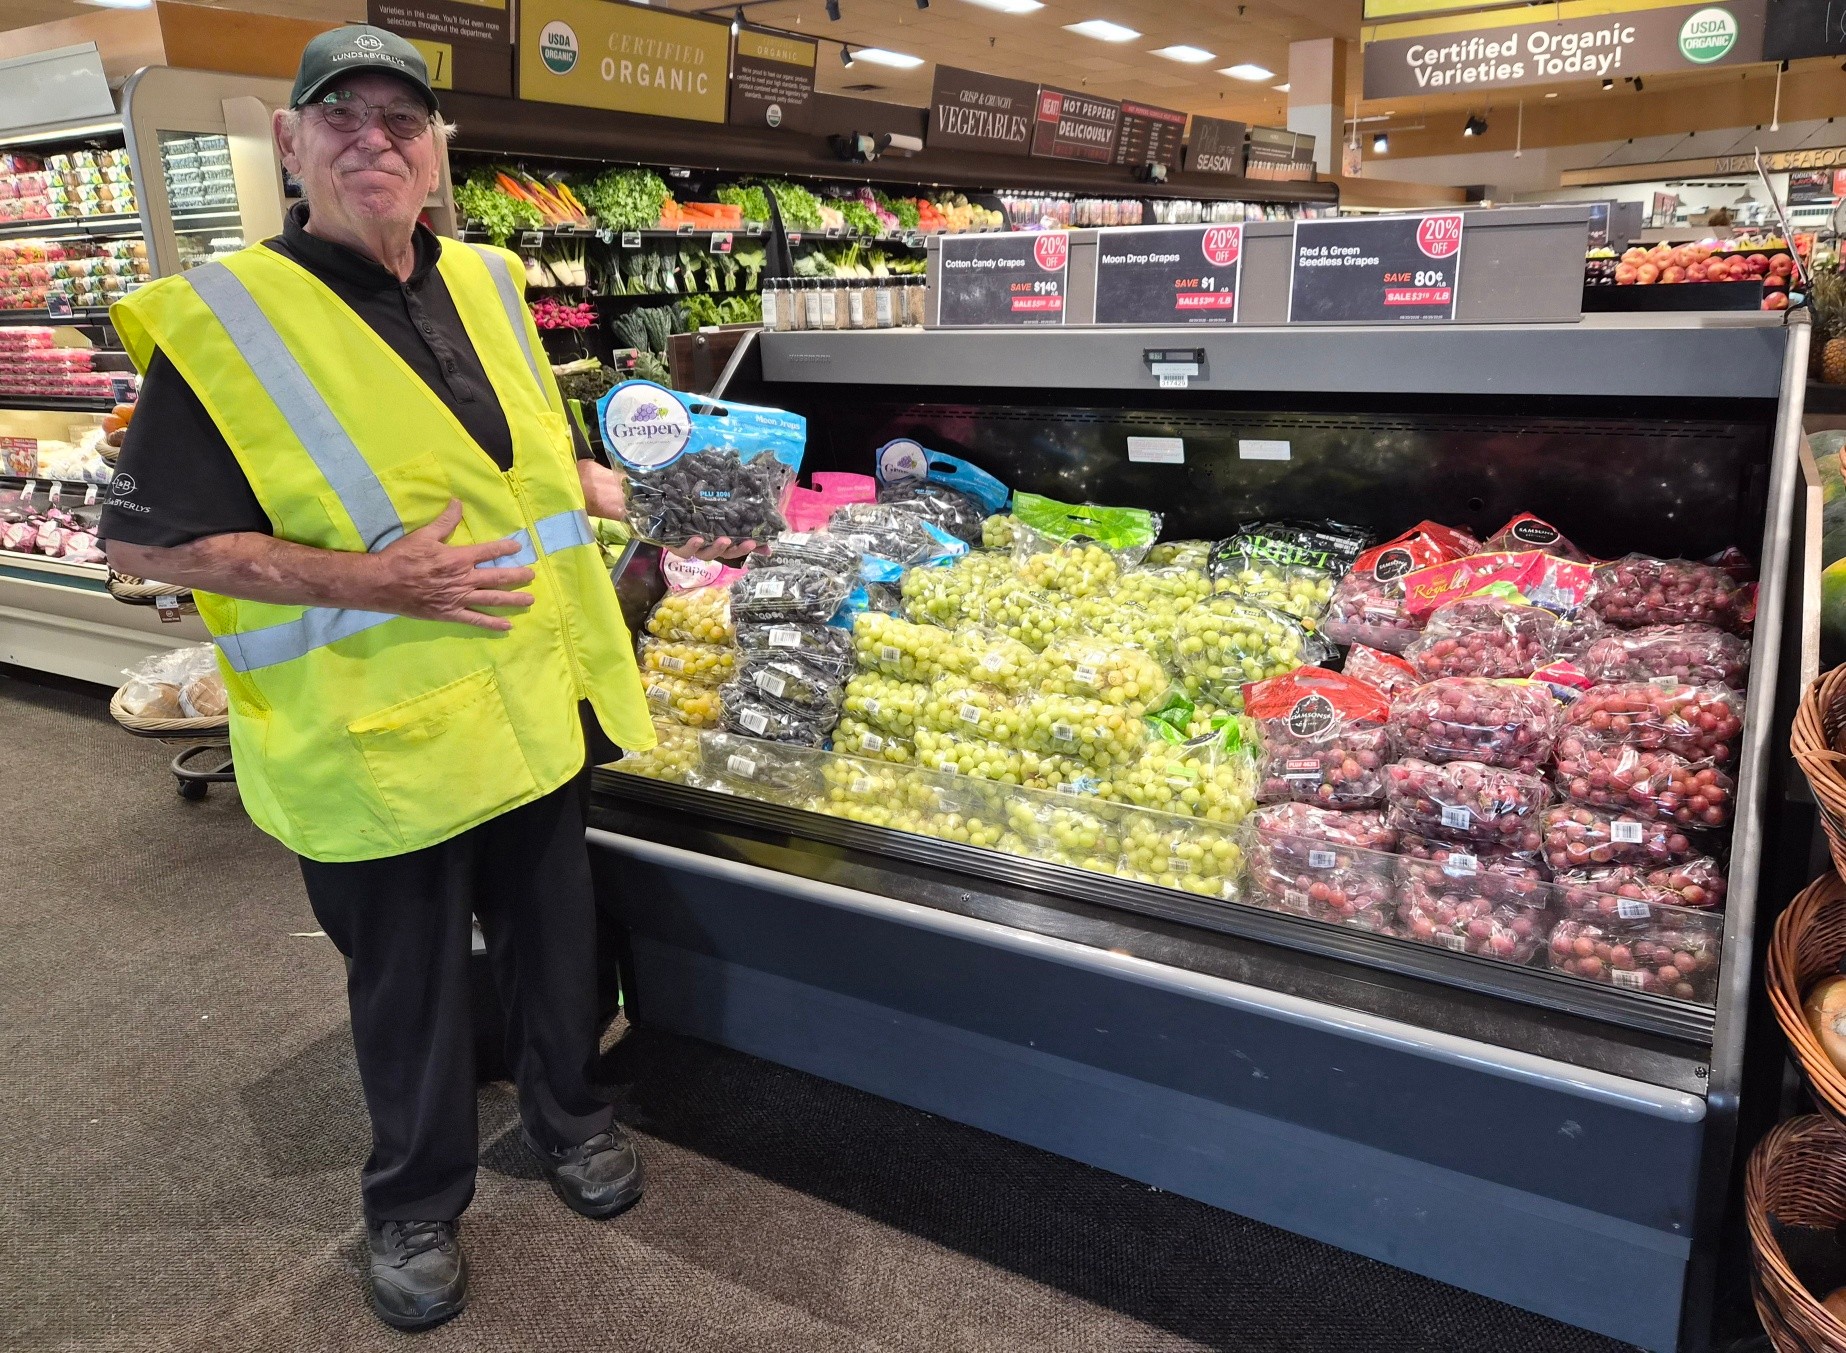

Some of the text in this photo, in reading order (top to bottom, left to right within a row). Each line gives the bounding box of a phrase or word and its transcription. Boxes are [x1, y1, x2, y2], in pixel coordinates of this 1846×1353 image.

[379, 4, 500, 31] Varieties in this case. You'll find even more
[387, 17, 493, 40] selections throughout the department.
[1691, 20, 1726, 35] USDA
[548, 32, 570, 47] USDA
[1406, 22, 1636, 67] Certified Organic
[1685, 35, 1730, 50] ORGANIC
[544, 48, 573, 62] ORGANIC
[608, 32, 705, 66] CERTIFIED
[757, 46, 798, 61] ORGANIC
[1414, 46, 1622, 88] Varieties Today!
[600, 57, 709, 95] ORGANIC
[959, 90, 1013, 110] CRISP & CRUNCHY
[1062, 98, 1081, 114] HOT
[1082, 103, 1116, 121] PEPPERS
[938, 105, 1028, 142] VEGETABLES
[1058, 120, 1113, 143] DELICIOUSLY
[1196, 154, 1232, 172] SEASON
[1425, 219, 1459, 240] 20%
[1040, 236, 1066, 255] 20%
[1209, 228, 1238, 249] 20%
[1300, 246, 1360, 256] Red & Green
[1432, 242, 1448, 254] OFF
[1046, 256, 1058, 268] OFF
[1102, 253, 1180, 265] Moon Drop Grapes
[1216, 250, 1229, 262] OFF
[1299, 256, 1380, 268] Seedless Grapes
[946, 258, 1026, 270] Cotton Candy Grapes
[1174, 276, 1215, 292] SAVE $1
[1384, 272, 1412, 282] SAVE
[1010, 282, 1032, 292] SAVE
[1014, 300, 1032, 308] SALE
[1178, 297, 1198, 305] SALE
[1218, 296, 1232, 304] /LB
[1387, 292, 1411, 302] SALE
[1433, 292, 1450, 300] /LB
[756, 414, 778, 426] Moon
[612, 423, 682, 439] Grapery
[1413, 569, 1470, 607] Royalty
